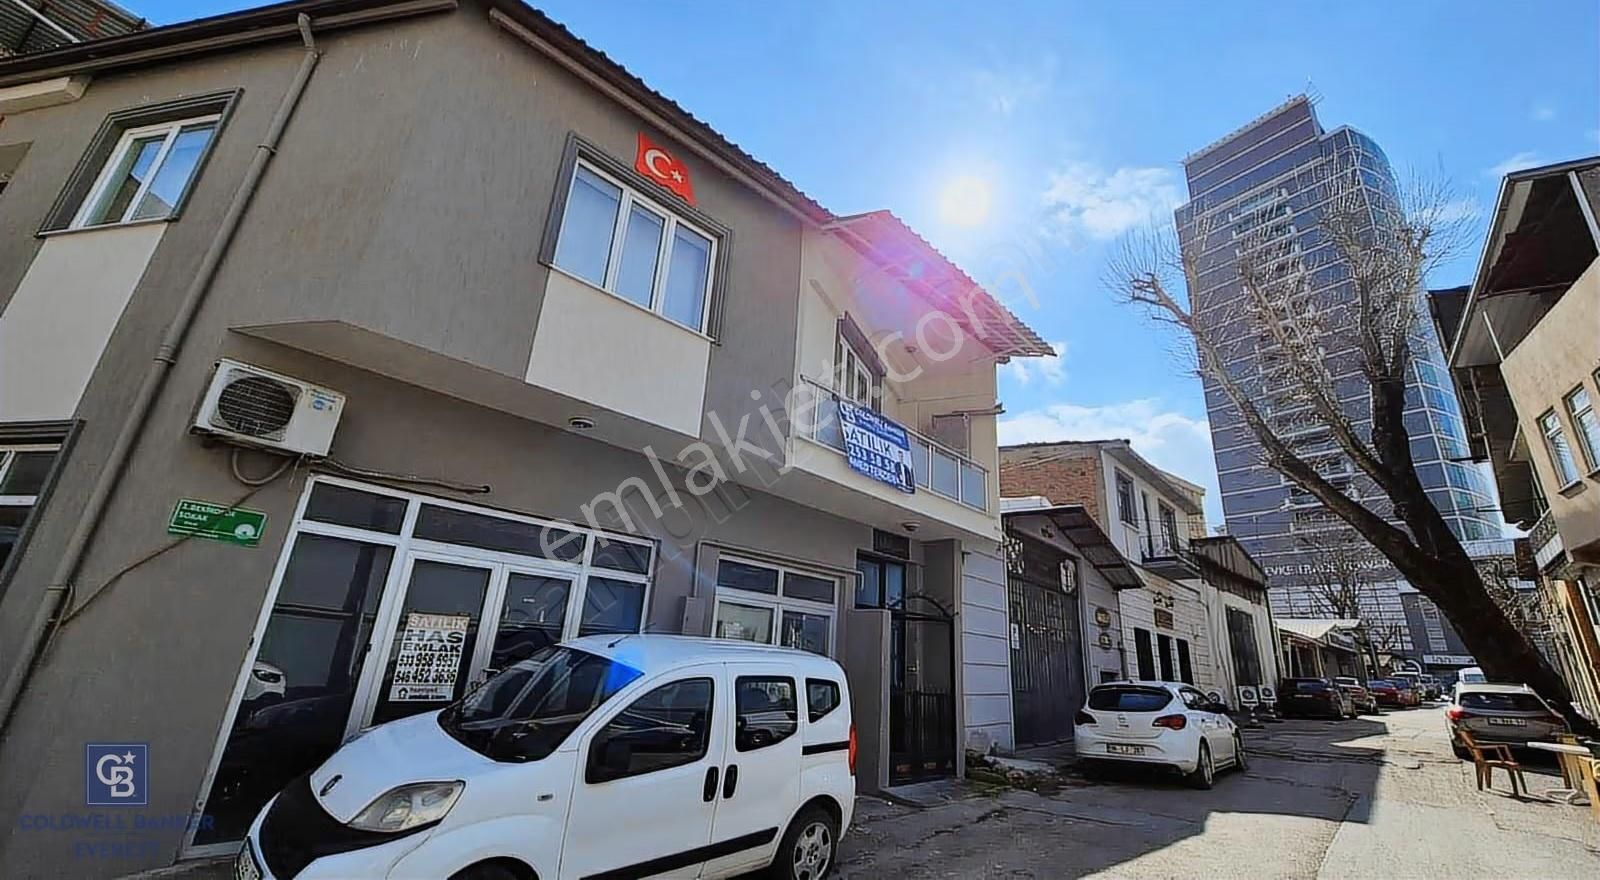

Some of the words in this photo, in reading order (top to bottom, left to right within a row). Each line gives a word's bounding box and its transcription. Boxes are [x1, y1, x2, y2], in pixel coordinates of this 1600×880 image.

[843, 424, 893, 457] SATILIK
[178, 511, 208, 522] SOKAK
[409, 614, 468, 630] SATILIK
[405, 629, 463, 643] HAS
[403, 642, 462, 653] EMLAK
[399, 655, 414, 667] 533
[415, 653, 434, 667] 958
[411, 668, 431, 684] 452
